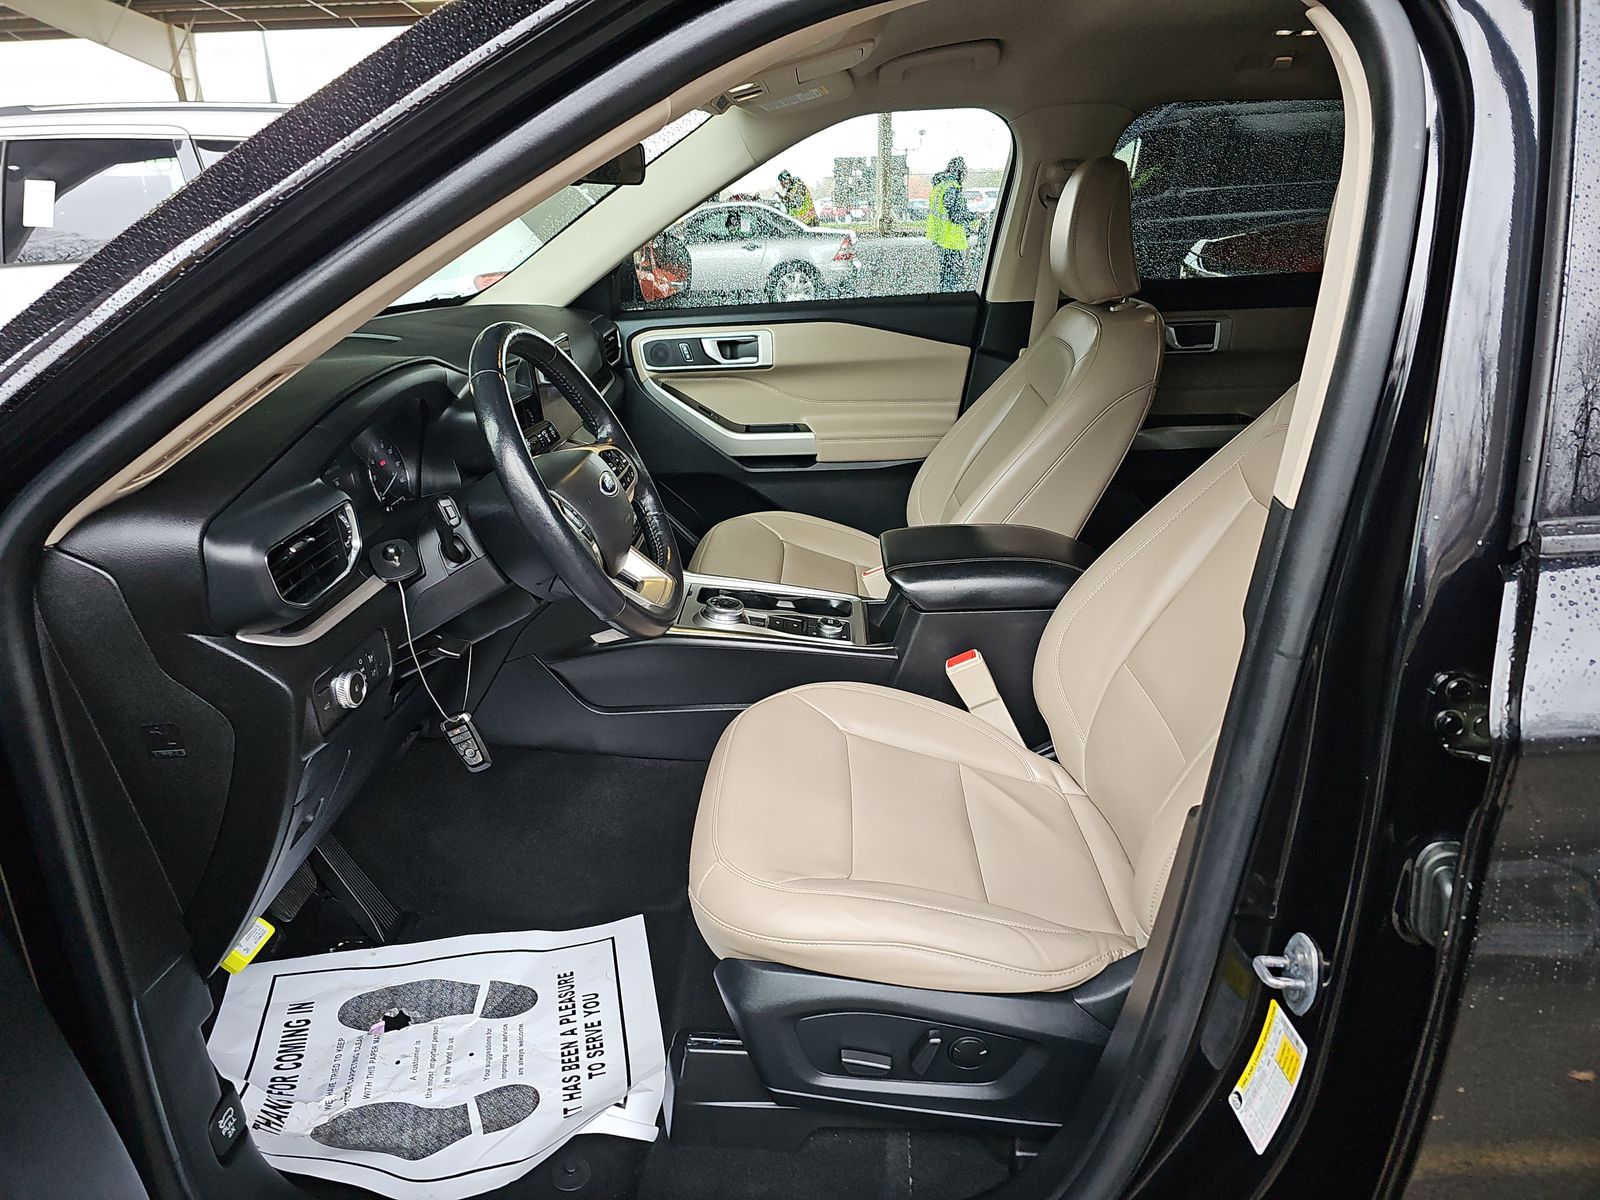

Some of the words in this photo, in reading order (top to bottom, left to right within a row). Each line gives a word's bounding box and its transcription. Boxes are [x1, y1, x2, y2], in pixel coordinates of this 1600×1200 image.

[557, 970, 577, 1025] PLEASURE
[582, 992, 601, 1018] YOU
[286, 1001, 316, 1014] IN
[432, 1025, 440, 1043] person
[484, 1027, 493, 1036] for
[501, 1023, 509, 1043] service
[560, 1027, 578, 1036] A
[584, 1019, 605, 1059] SERVE
[273, 1018, 312, 1071] COMING
[336, 1037, 346, 1053] KEEP
[485, 1035, 493, 1068] suggestions
[333, 1053, 343, 1062] TO
[368, 1045, 379, 1064] PAPER
[412, 1046, 421, 1074] customer
[428, 1043, 438, 1070] important
[517, 1048, 526, 1066] always
[560, 1040, 580, 1072] BEEN
[330, 1063, 341, 1081] TRIED
[366, 1065, 376, 1079] THIS
[427, 1071, 435, 1087] most
[444, 1065, 452, 1076] the
[482, 1068, 491, 1081] Your
[587, 1062, 607, 1080] TO
[266, 1074, 300, 1097] FOR
[325, 1081, 337, 1097] HAVE
[362, 1081, 373, 1100] WITH
[425, 1087, 433, 1099] the
[561, 1074, 582, 1102] HAS
[324, 1099, 334, 1111] WE
[562, 1105, 583, 1119] IT
[221, 1117, 237, 1136] PULL
